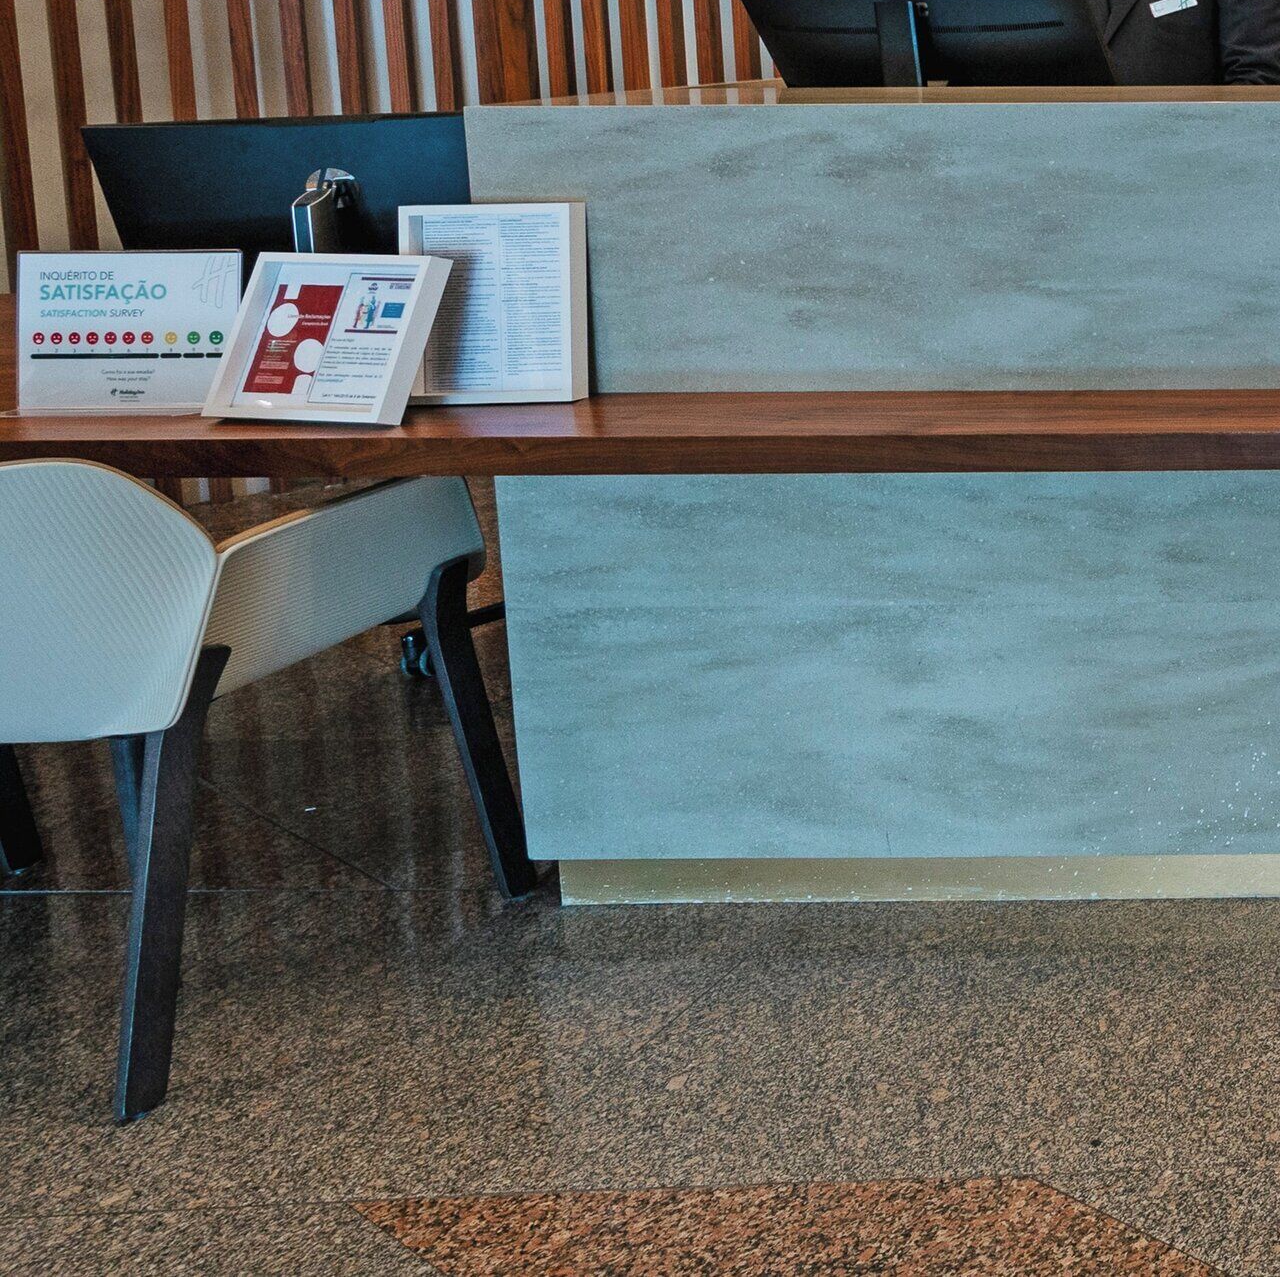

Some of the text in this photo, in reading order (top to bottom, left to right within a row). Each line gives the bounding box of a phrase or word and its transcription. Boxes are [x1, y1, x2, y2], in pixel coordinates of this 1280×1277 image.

[40, 269, 114, 281] INQUÉRITO DE
[40, 280, 167, 304] SATISFAÇÃO
[40, 308, 145, 318] SATISFACTION SURVEY
